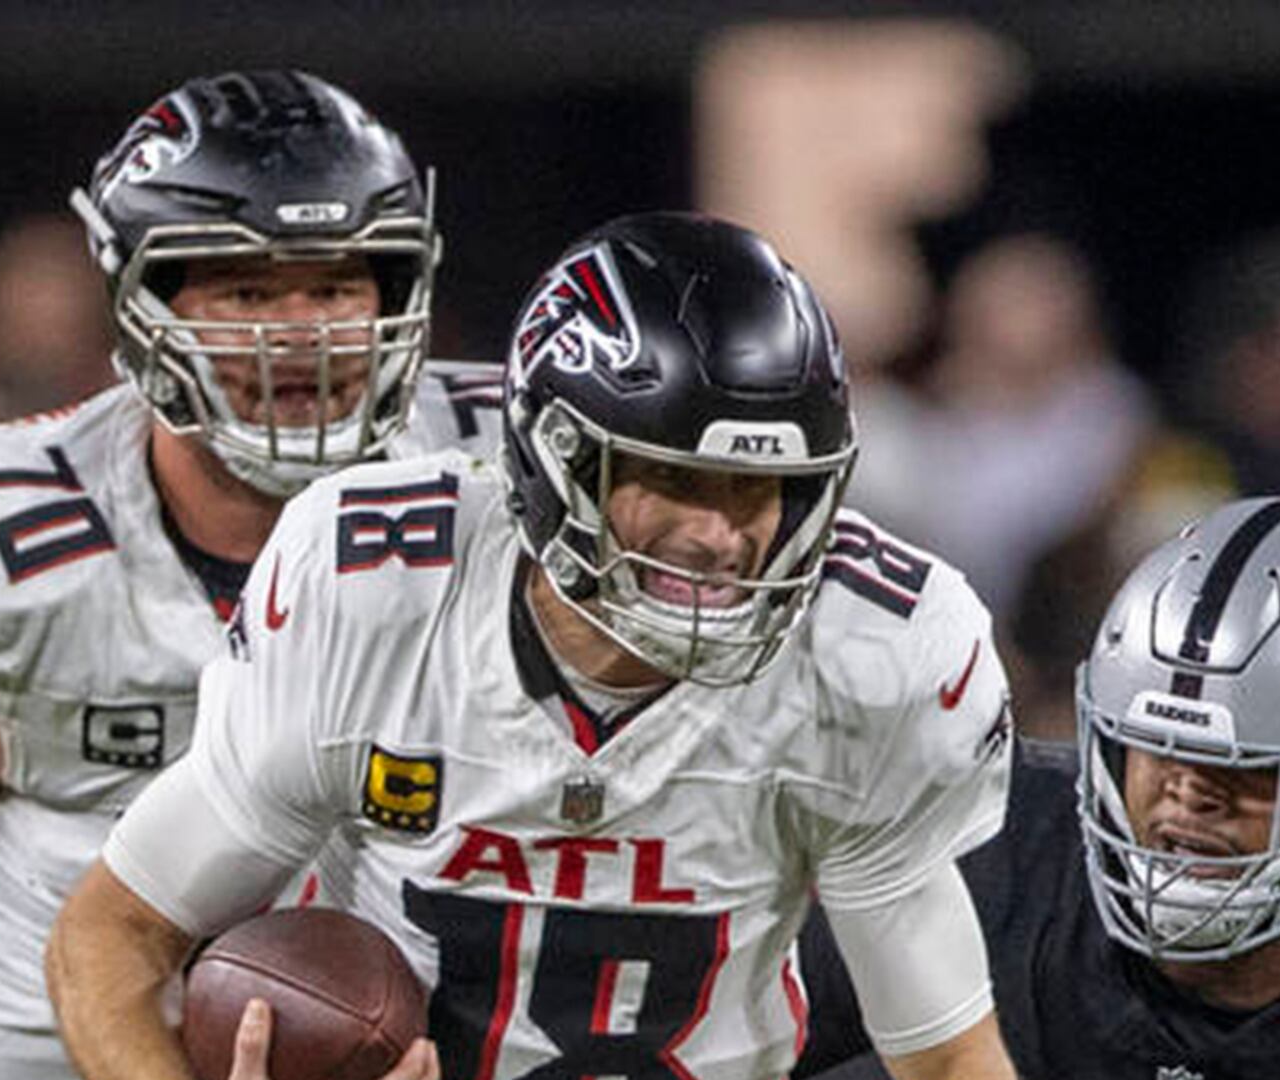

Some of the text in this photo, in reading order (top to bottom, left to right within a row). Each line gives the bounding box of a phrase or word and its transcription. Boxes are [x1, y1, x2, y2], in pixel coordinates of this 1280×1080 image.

[728, 434, 785, 456] ATL
[336, 470, 460, 575] 18
[820, 520, 933, 621] 18
[88, 710, 161, 755] C
[1144, 699, 1212, 729] RAIDERS
[369, 750, 437, 815] C
[435, 822, 695, 904] ATL
